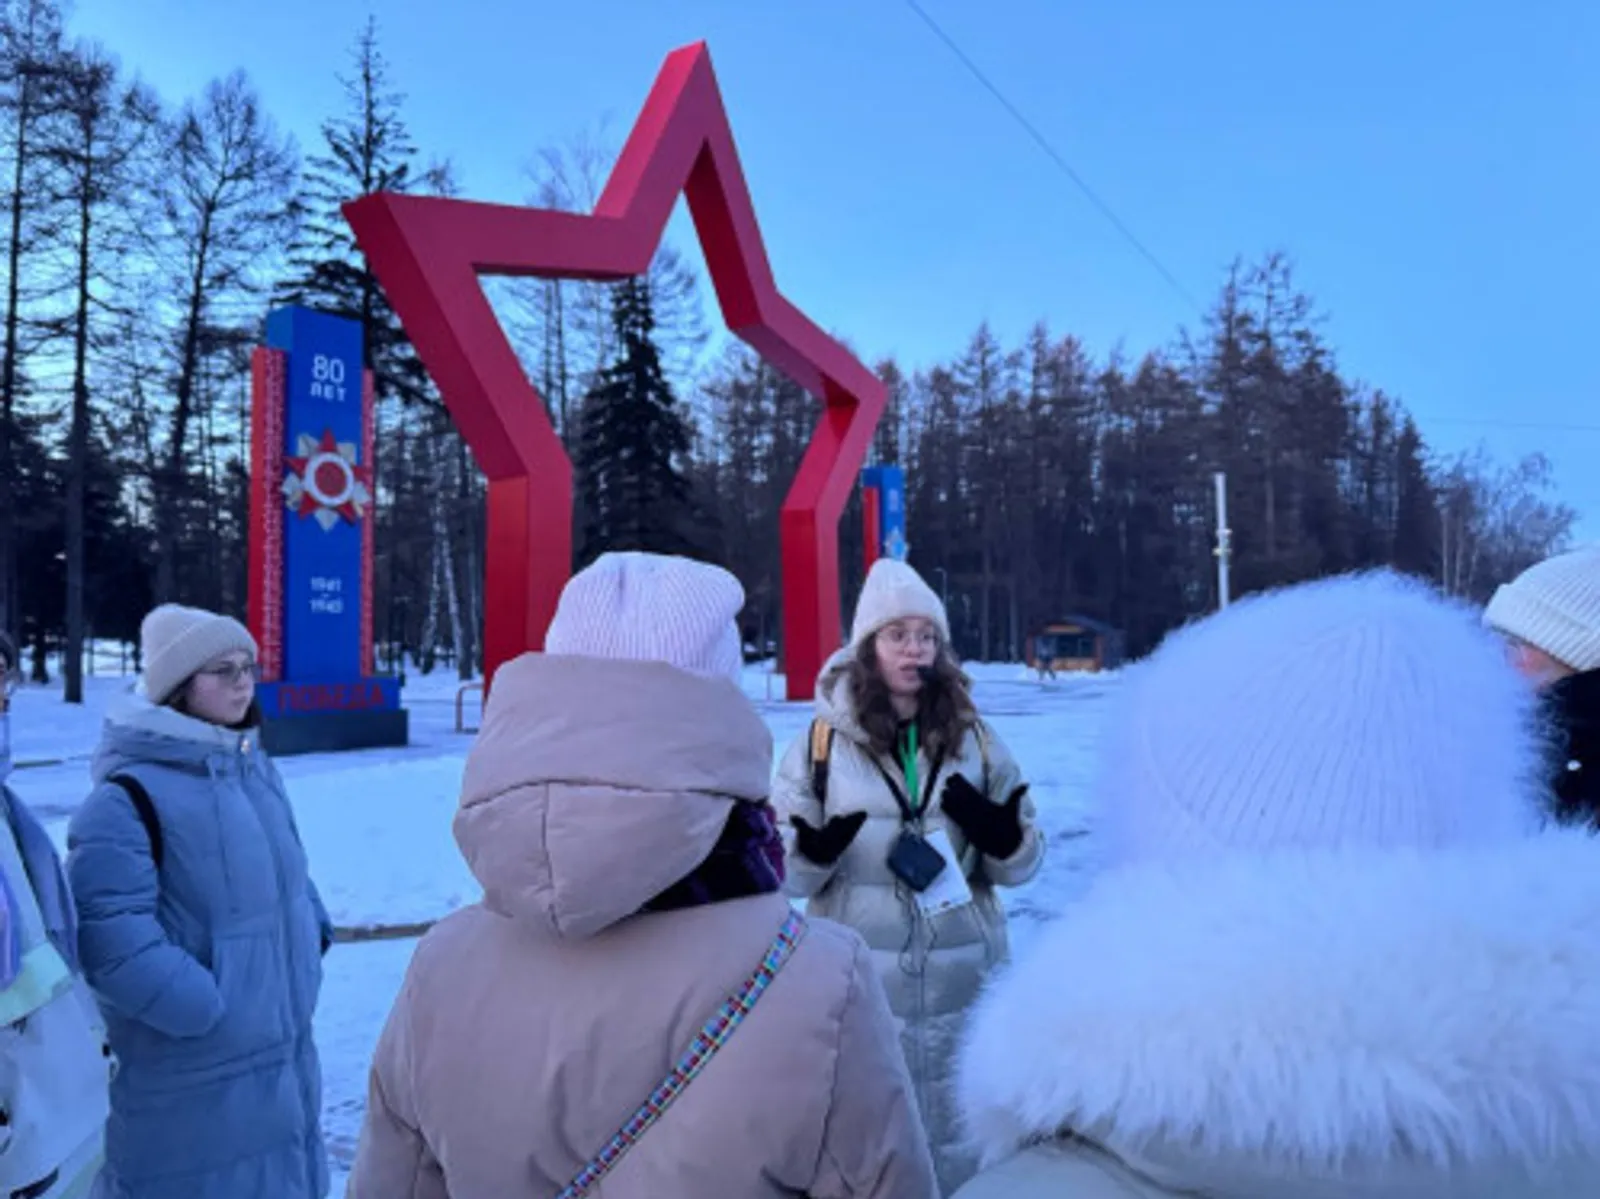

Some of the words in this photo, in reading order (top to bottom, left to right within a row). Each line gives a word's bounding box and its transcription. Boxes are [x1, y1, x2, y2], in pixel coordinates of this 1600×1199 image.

[313, 354, 345, 383] 80
[310, 381, 346, 401] ЛЕТ
[278, 682, 384, 712] ПОБЕДА
